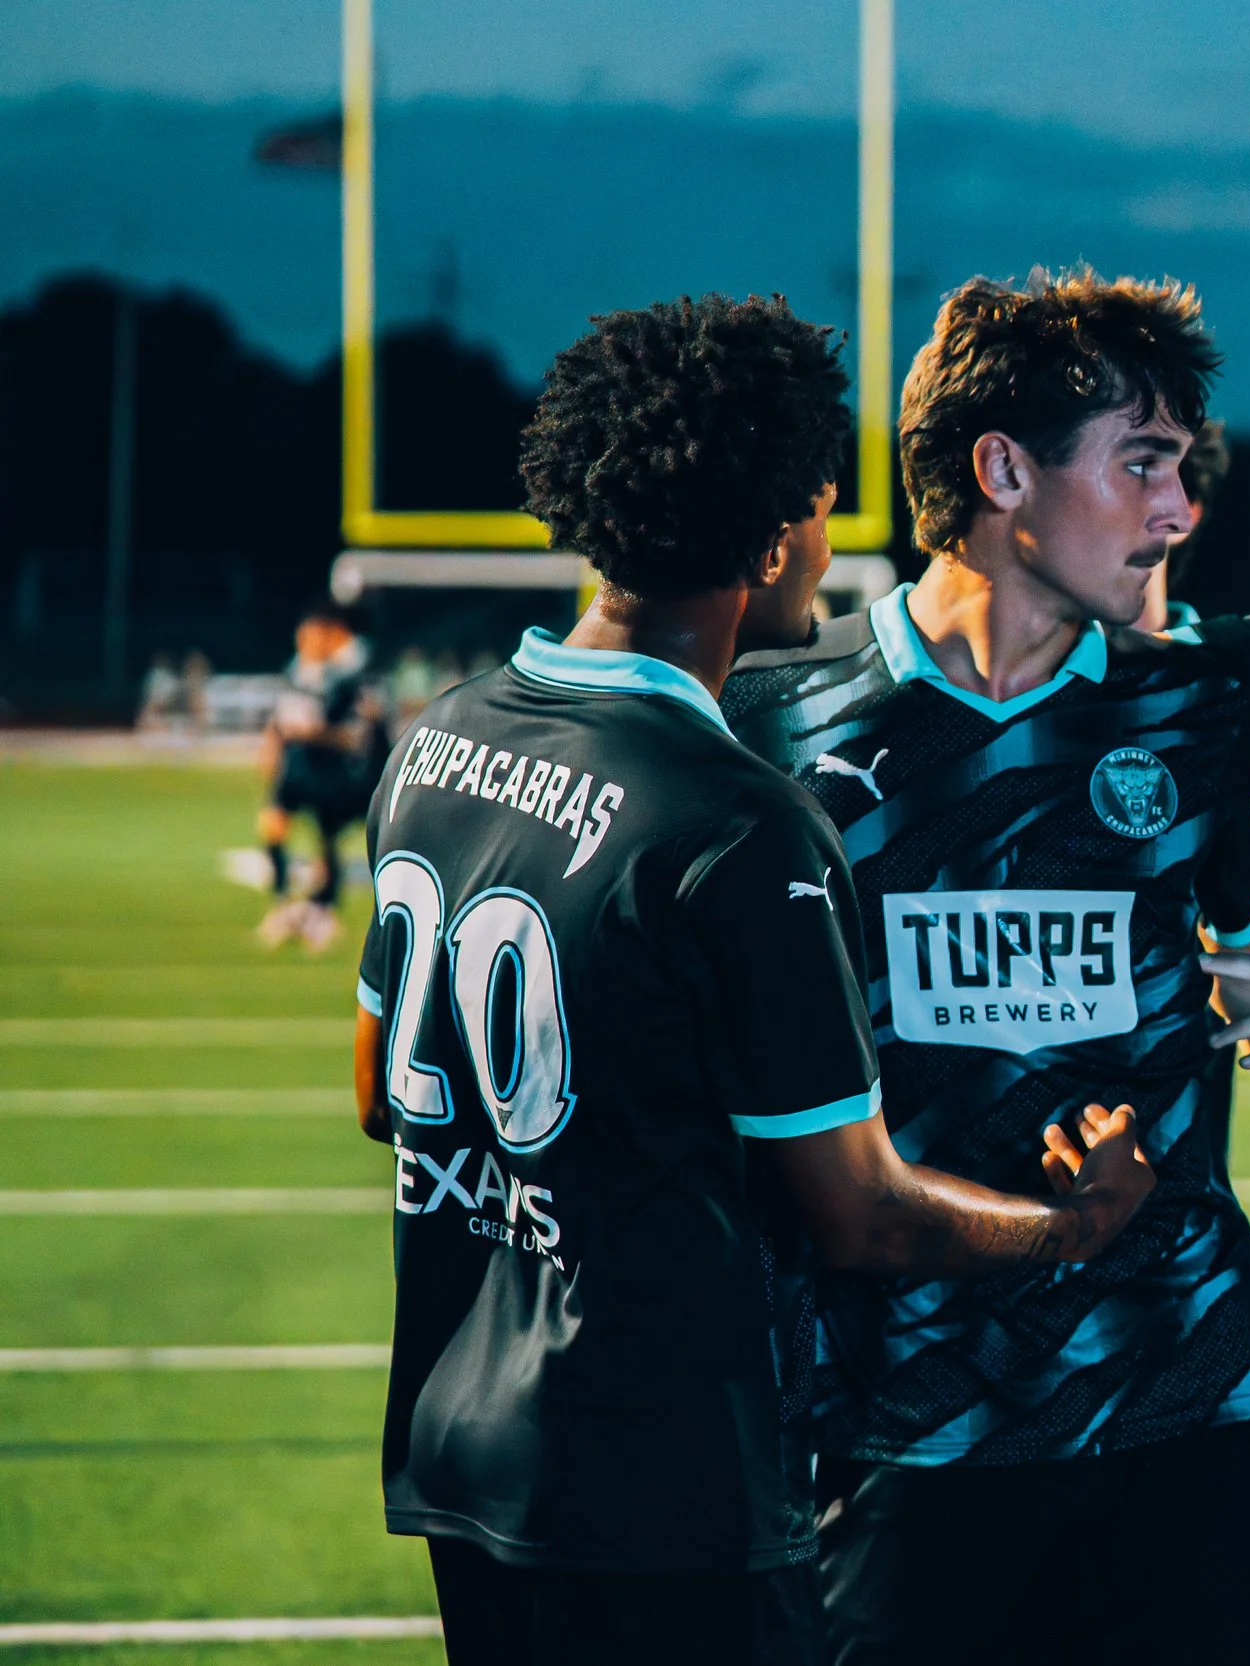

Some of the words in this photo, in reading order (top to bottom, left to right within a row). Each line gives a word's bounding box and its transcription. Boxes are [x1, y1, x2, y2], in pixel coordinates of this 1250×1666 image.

[389, 726, 625, 880] CHUPACABRAS
[375, 850, 578, 1154] 20
[902, 911, 1117, 991] TUPPS
[934, 1002, 1098, 1026] BREWERY
[394, 1133, 560, 1248] EXANS
